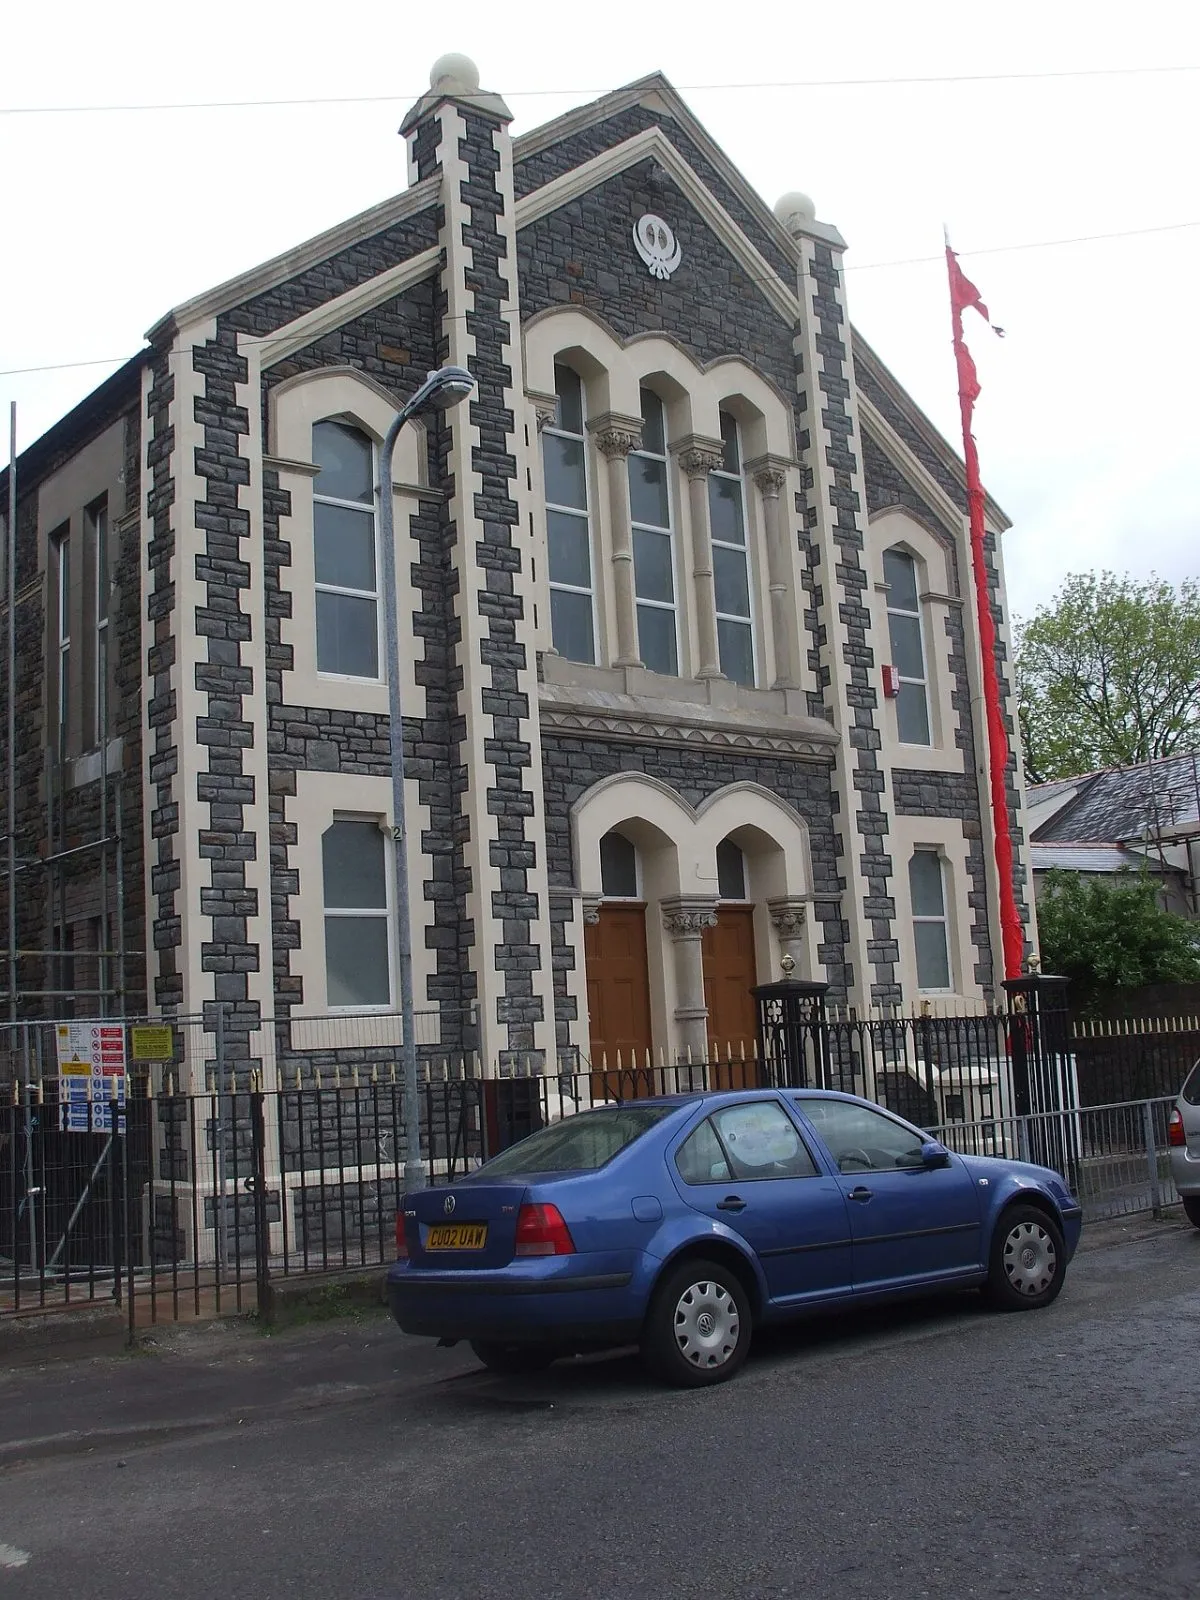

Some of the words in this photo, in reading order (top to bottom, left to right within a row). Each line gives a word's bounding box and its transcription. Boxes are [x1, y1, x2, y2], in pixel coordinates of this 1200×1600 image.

[394, 827, 401, 839] 2
[431, 1229, 457, 1246] CU02
[459, 1229, 482, 1245] UAW
